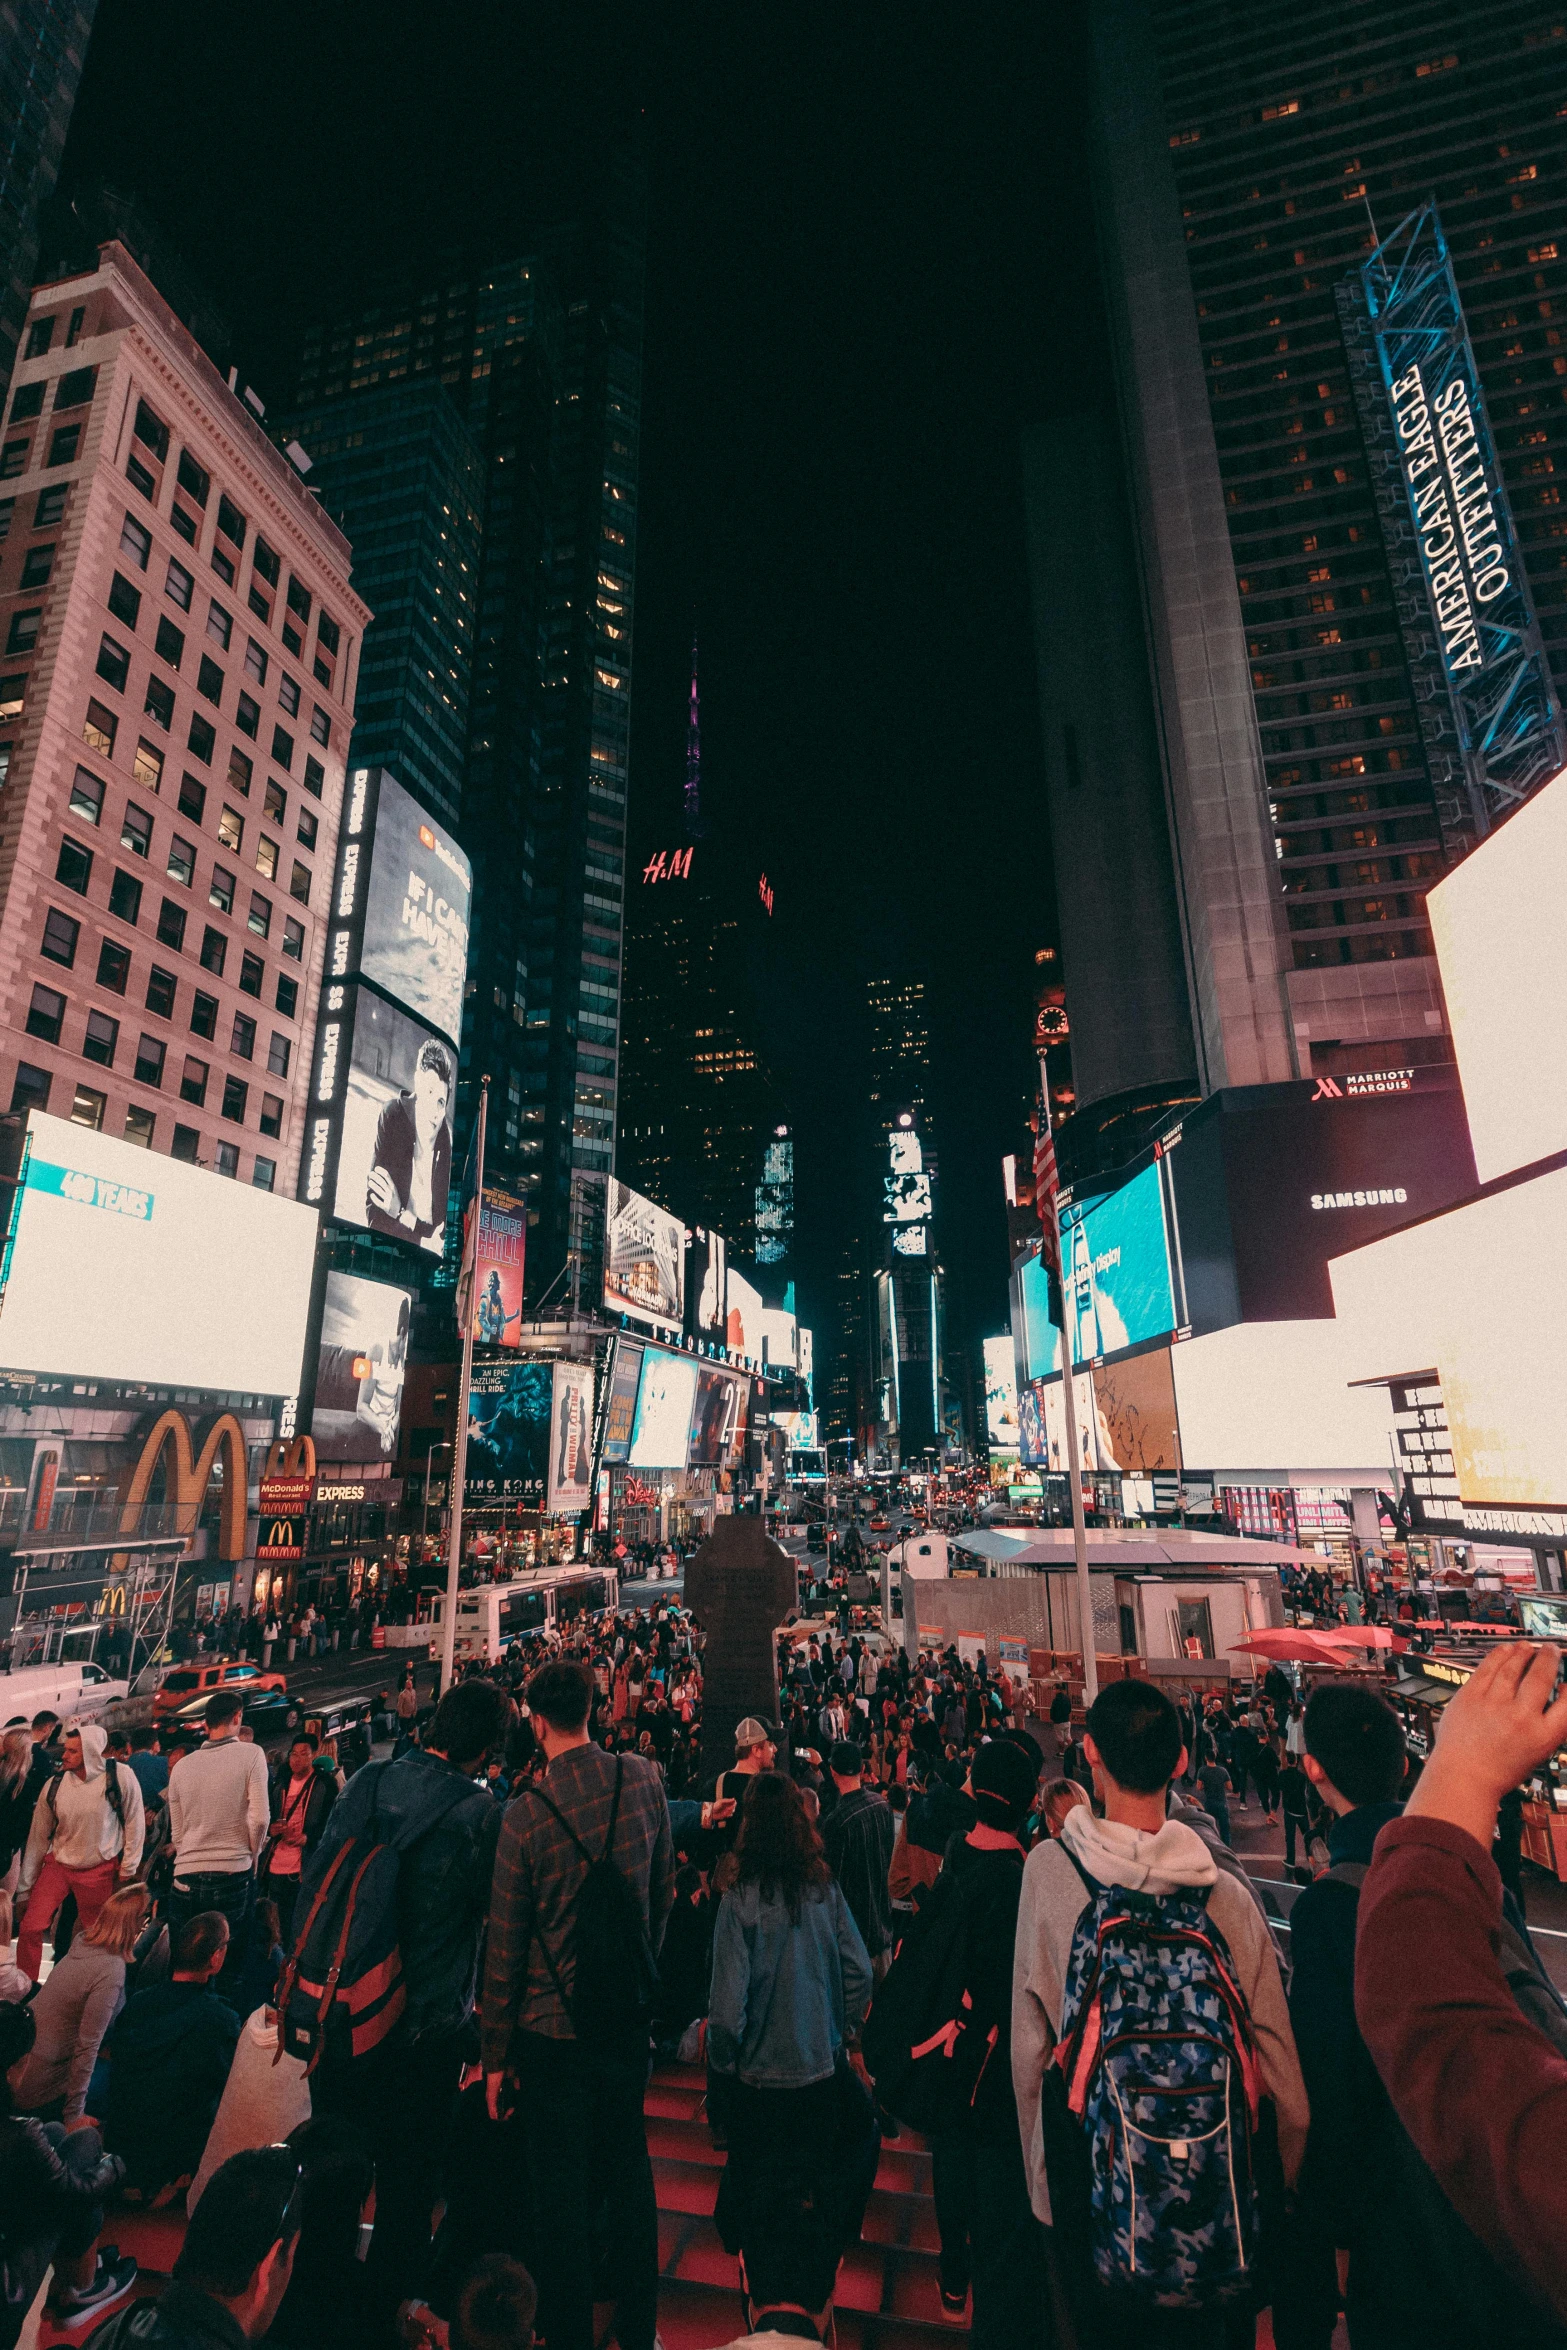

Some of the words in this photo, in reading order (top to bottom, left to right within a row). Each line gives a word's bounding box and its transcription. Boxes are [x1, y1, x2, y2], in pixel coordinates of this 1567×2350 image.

[1392, 362, 1441, 467] EAGLE
[1433, 377, 1510, 604] OUTFITTERS
[1416, 474, 1483, 671] AMERICAN
[348, 769, 368, 834] EXPRESS
[339, 844, 360, 916] EXPRESS
[642, 846, 694, 885] H&M
[408, 871, 426, 902] IF
[426, 887, 434, 914] I
[402, 897, 449, 955] HAVE
[318, 1023, 341, 1101] EXPRESS
[1346, 1069, 1415, 1084] MARRIOTT
[1347, 1080, 1409, 1094] MARQUIS
[307, 1119, 330, 1200] EXPRESS
[1311, 1188, 1408, 1211] SAMSUNG
[492, 1212, 522, 1238] MORE
[570, 1387, 579, 1427] PRETTY
[720, 1383, 741, 1444] 21
[567, 1434, 577, 1479] WOMAN
[261, 1483, 310, 1494] McDonald's
[317, 1486, 365, 1501] EXPRESS
